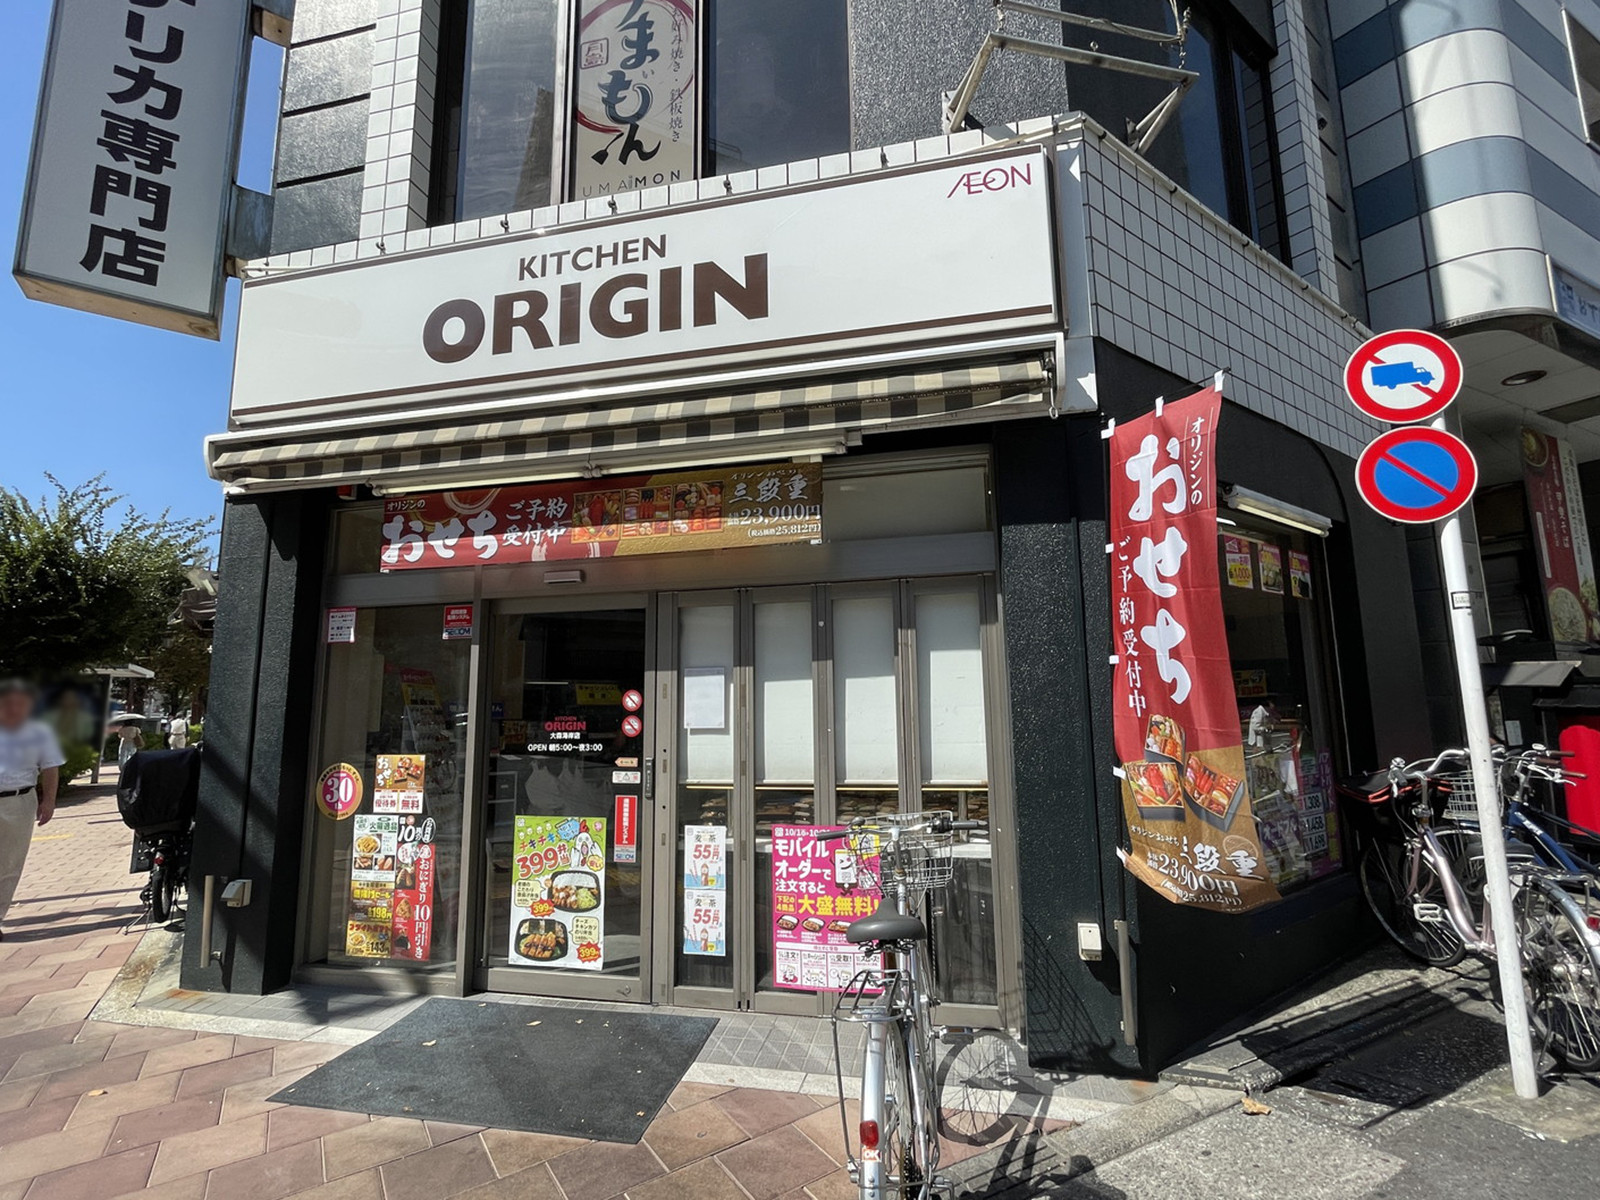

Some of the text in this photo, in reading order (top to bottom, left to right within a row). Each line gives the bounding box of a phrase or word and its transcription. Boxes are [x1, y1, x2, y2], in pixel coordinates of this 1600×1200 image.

[79, 0, 196, 287] リカ専門店
[519, 234, 667, 281] KITCHEN
[422, 252, 769, 364] ORIGIN
[1190, 416, 1205, 505] オリジンの
[729, 473, 808, 503] 三段重
[387, 500, 426, 511] オリジンの
[505, 497, 567, 520] ご予約
[381, 509, 499, 564] おせち
[502, 521, 567, 546] 受付中
[1125, 434, 1192, 704] おせち
[1118, 536, 1147, 718] ご予約受付中
[544, 721, 587, 731] ORIGIN
[527, 743, 547, 752] OPEN
[377, 757, 392, 787] おせち
[325, 777, 353, 803] 30
[775, 837, 830, 858] モバイル
[516, 847, 559, 879] 399
[775, 859, 832, 880] オーダーで
[775, 879, 826, 894] 注文すると
